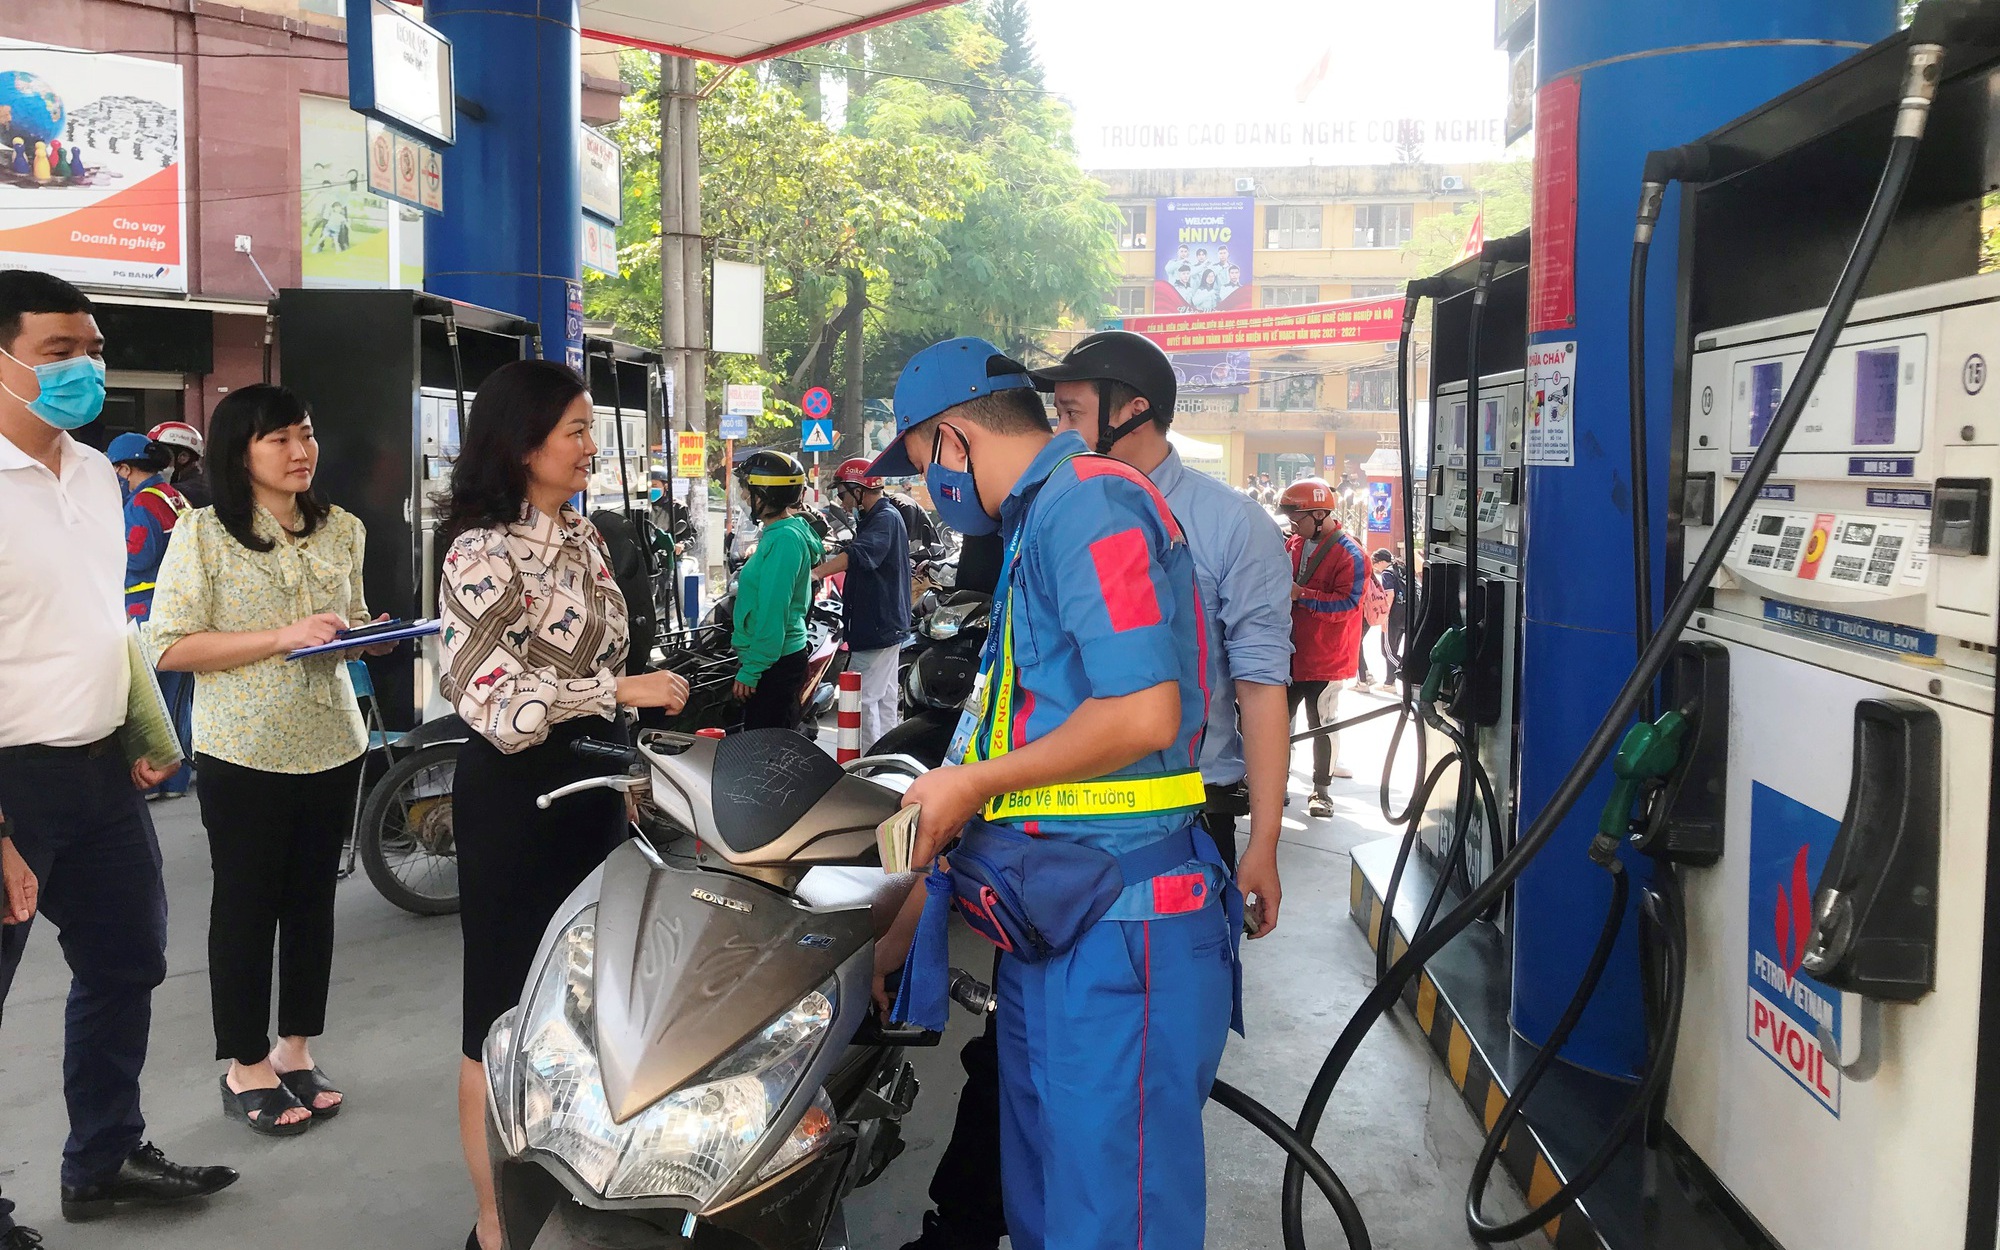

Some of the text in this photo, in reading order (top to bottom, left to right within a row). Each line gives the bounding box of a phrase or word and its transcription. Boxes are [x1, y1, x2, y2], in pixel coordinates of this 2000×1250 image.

[113, 218, 165, 235] Cho vay
[1185, 217, 1224, 225] WELCOME
[71, 231, 166, 252] Doanh nghiệp
[1178, 227, 1232, 243] HNIVC
[1322, 329, 1336, 338] 2021
[1341, 327, 1356, 337] 2022
[1543, 350, 1566, 365] CHÁY
[1969, 363, 1983, 384] 15
[680, 436, 703, 448] PHOTO
[682, 453, 702, 466] COPY
[1872, 630, 1890, 643] KHI
[1894, 633, 1919, 651] BƠM
[998, 683, 1010, 723] RON
[993, 728, 1003, 750] 92
[1036, 790, 1052, 810] Vệ
[1057, 790, 1078, 807] Môi
[1083, 788, 1136, 808] Trường
[690, 887, 754, 914] HONDA
[1755, 950, 1833, 1032] PETROVIETNAM
[1754, 999, 1830, 1099] PVOIL
